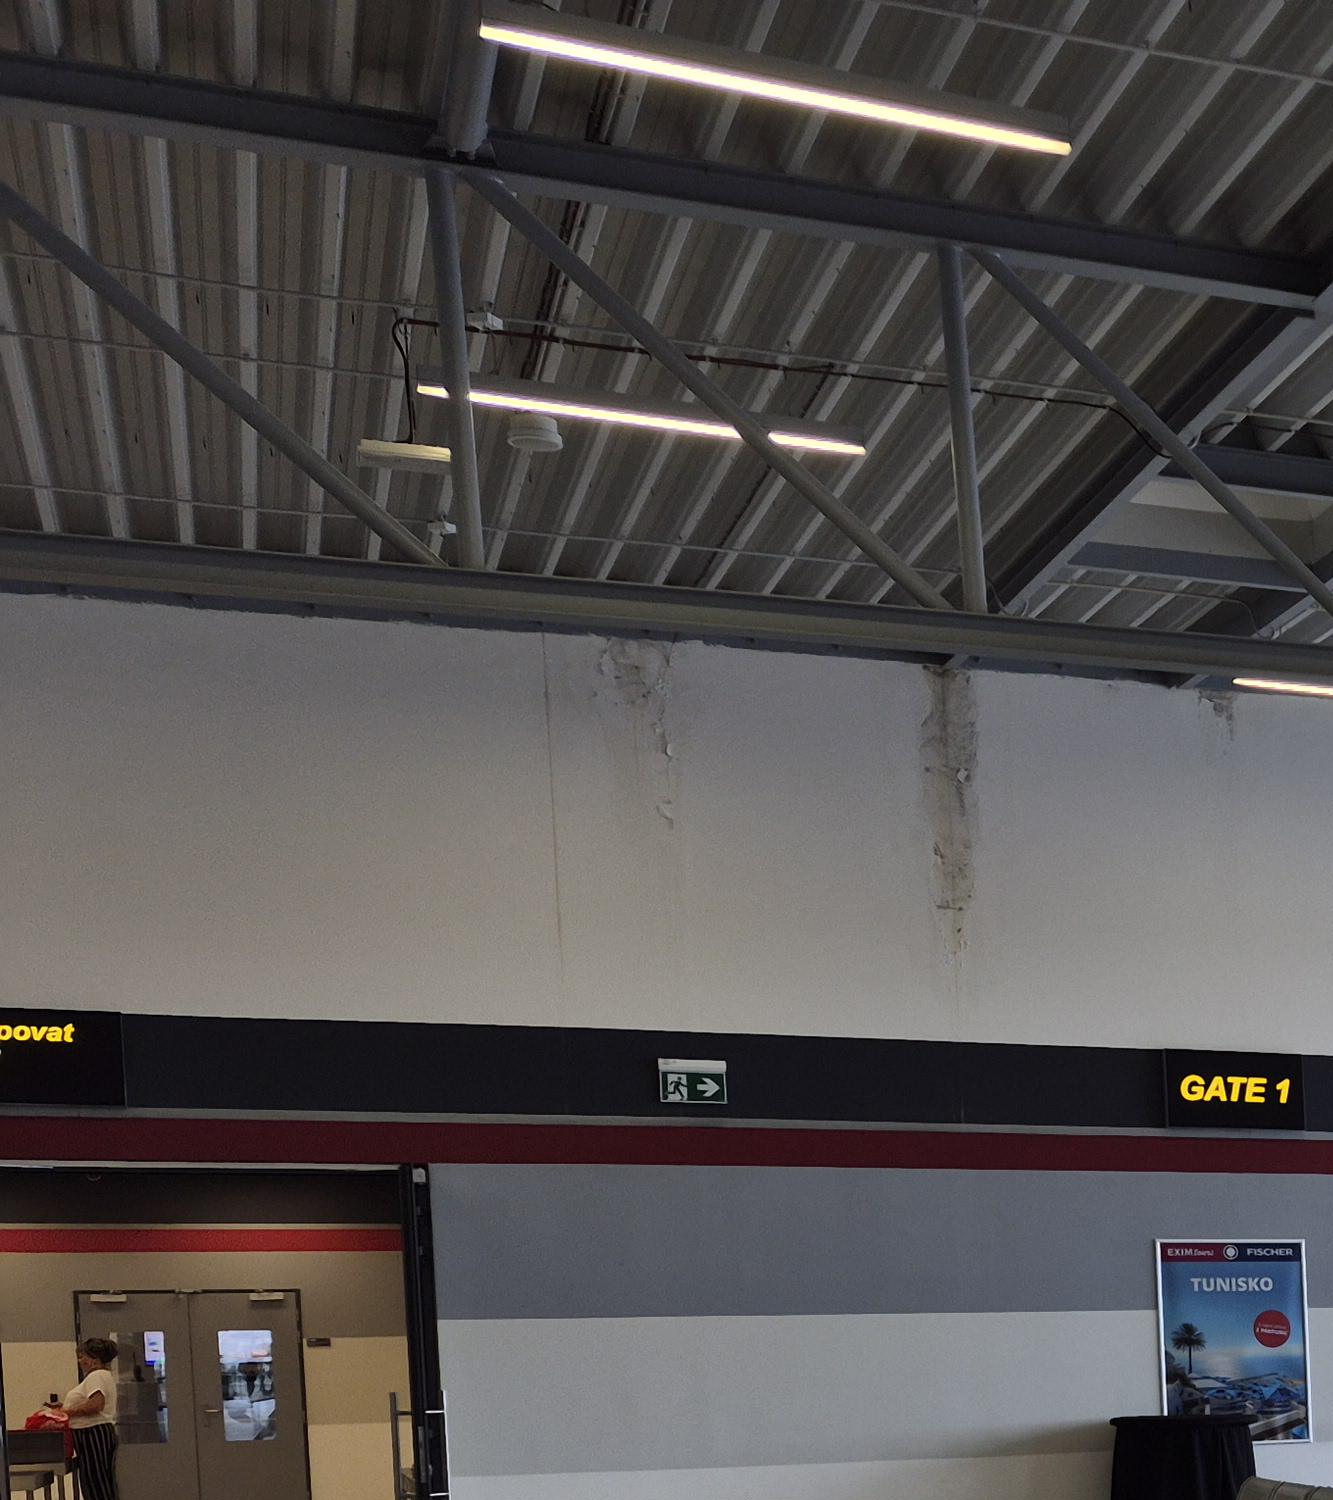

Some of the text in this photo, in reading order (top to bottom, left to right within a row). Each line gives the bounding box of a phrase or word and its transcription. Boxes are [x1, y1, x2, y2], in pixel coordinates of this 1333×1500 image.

[1180, 1074, 1290, 1104] GATE 1
[1247, 1248, 1293, 1256] FISCHER
[1190, 1277, 1274, 1292] TUNISKO
